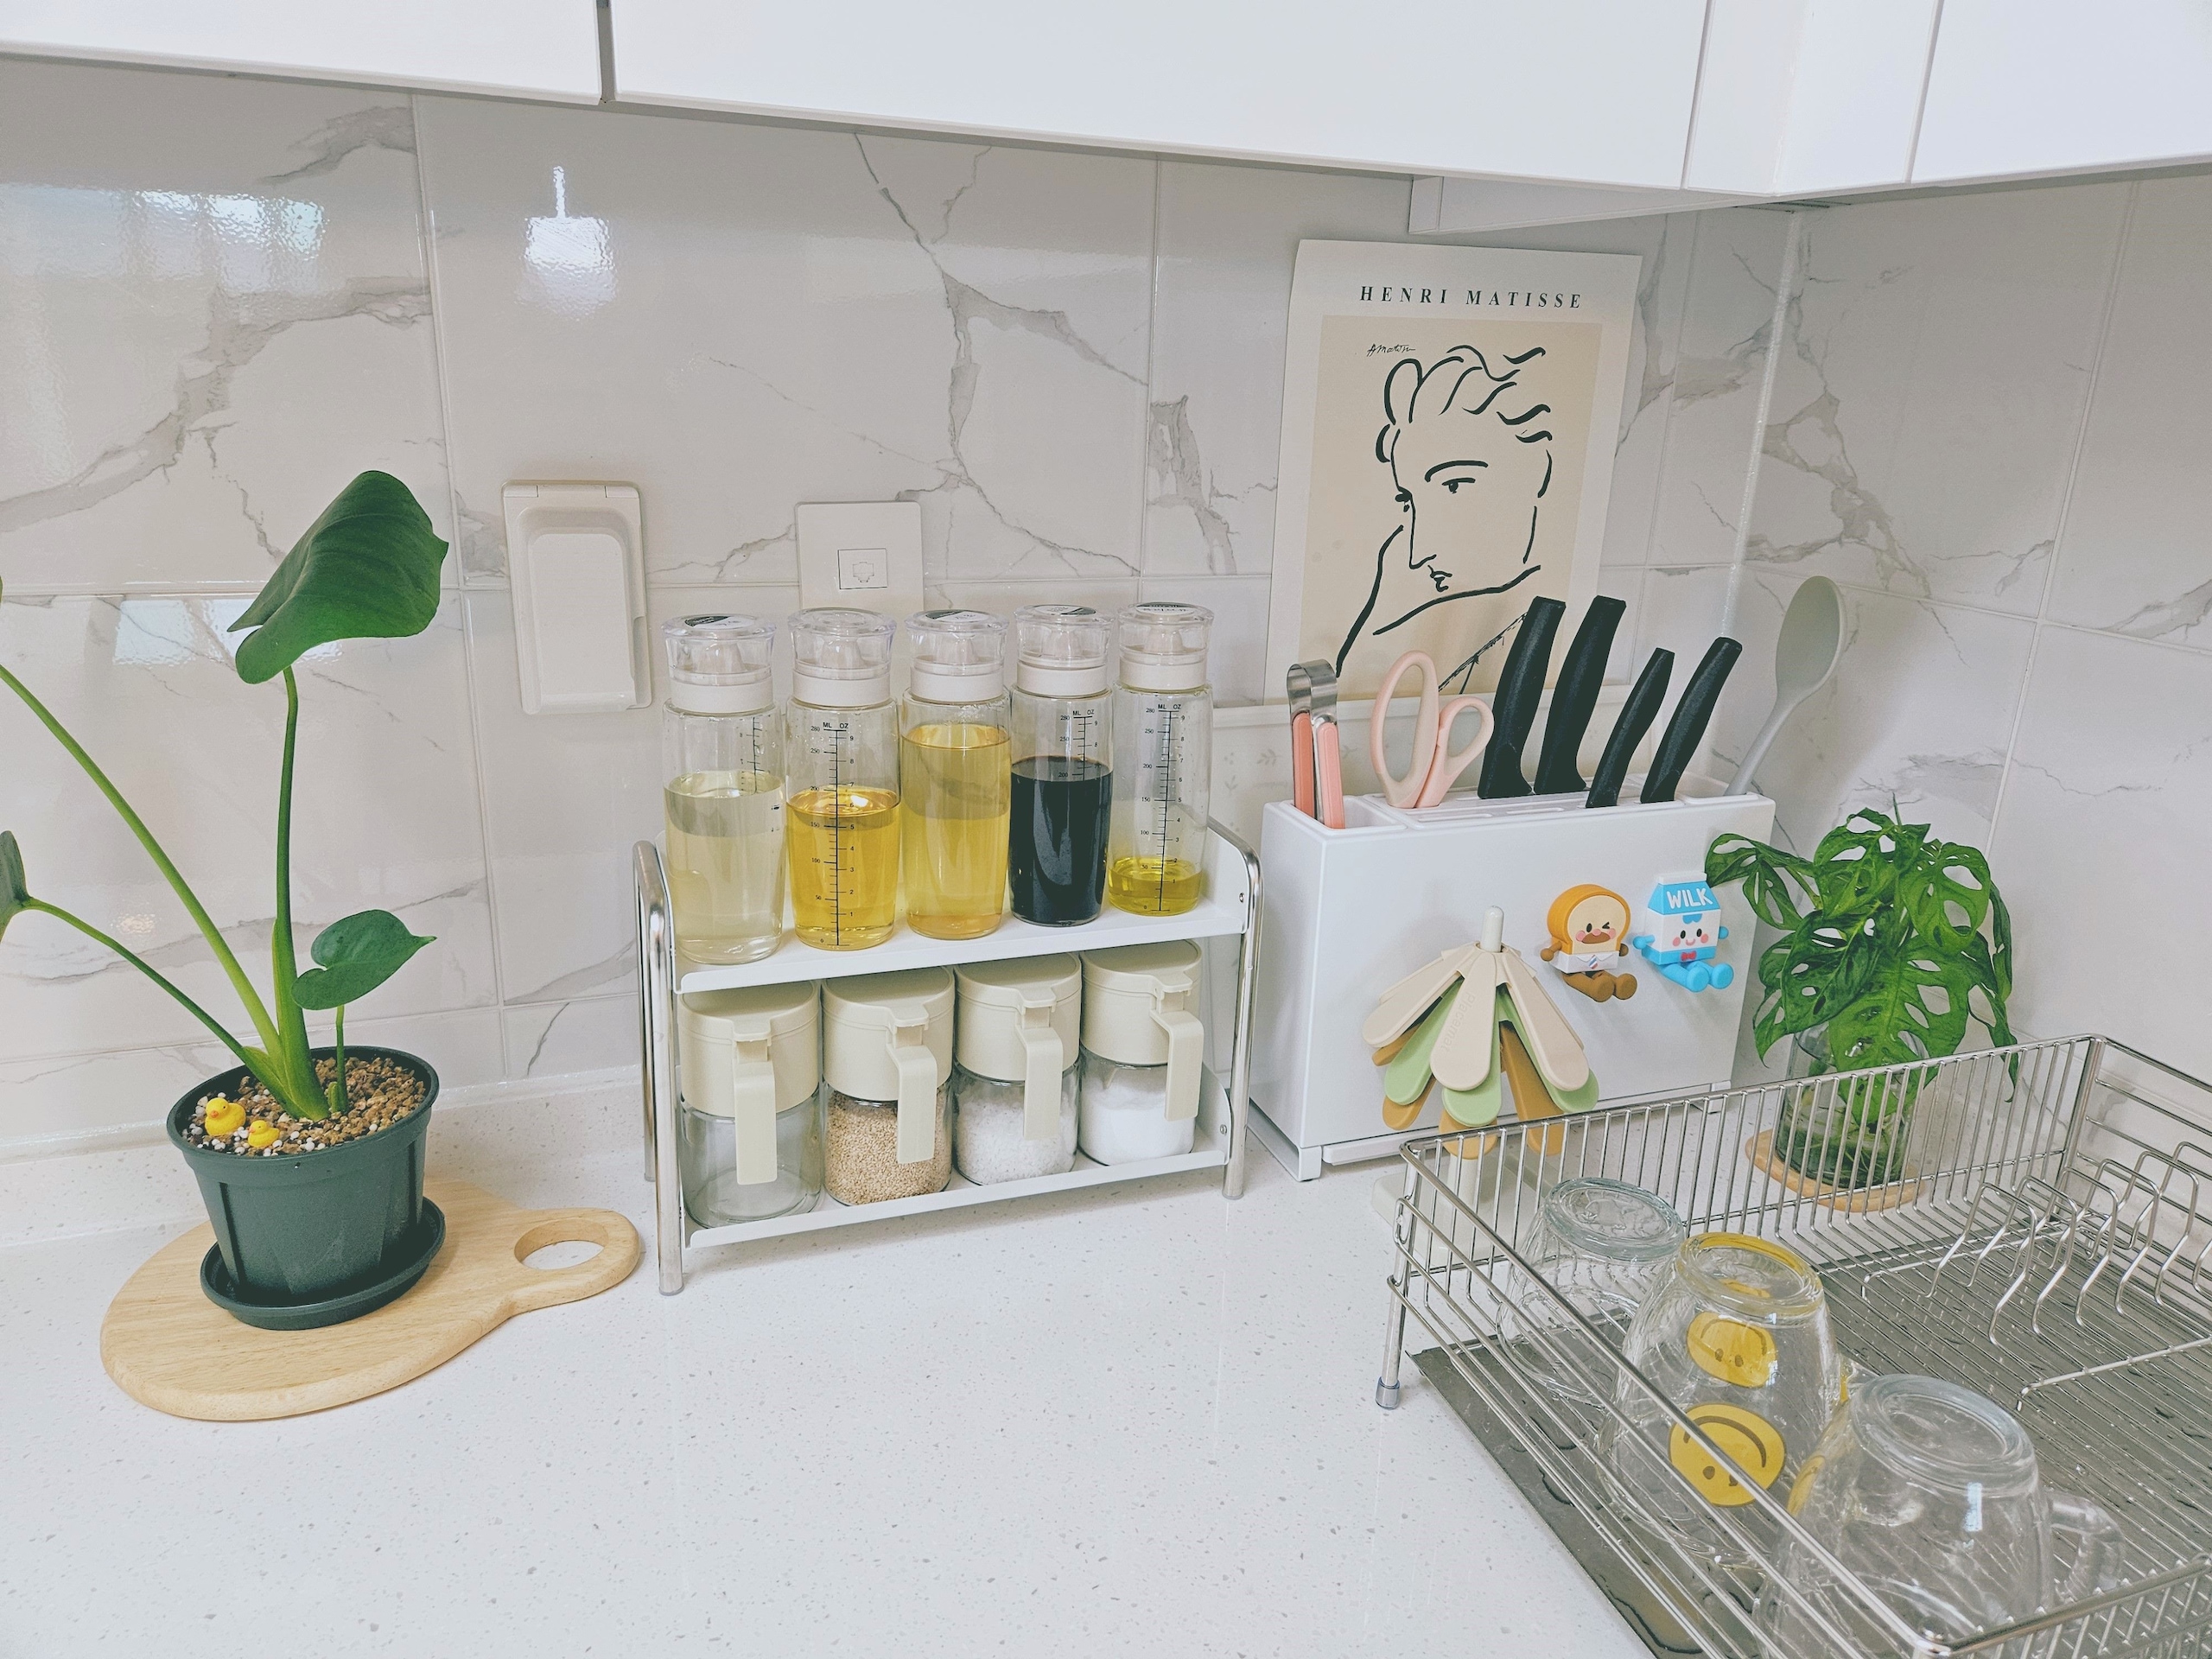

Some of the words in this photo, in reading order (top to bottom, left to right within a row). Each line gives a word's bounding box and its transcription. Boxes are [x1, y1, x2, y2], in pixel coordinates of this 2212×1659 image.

[1359, 285, 1447, 304] HENRI
[1465, 289, 1580, 308] MATISSE
[1666, 887, 1713, 909] WILK
[1440, 991, 1476, 1053] Placemat
